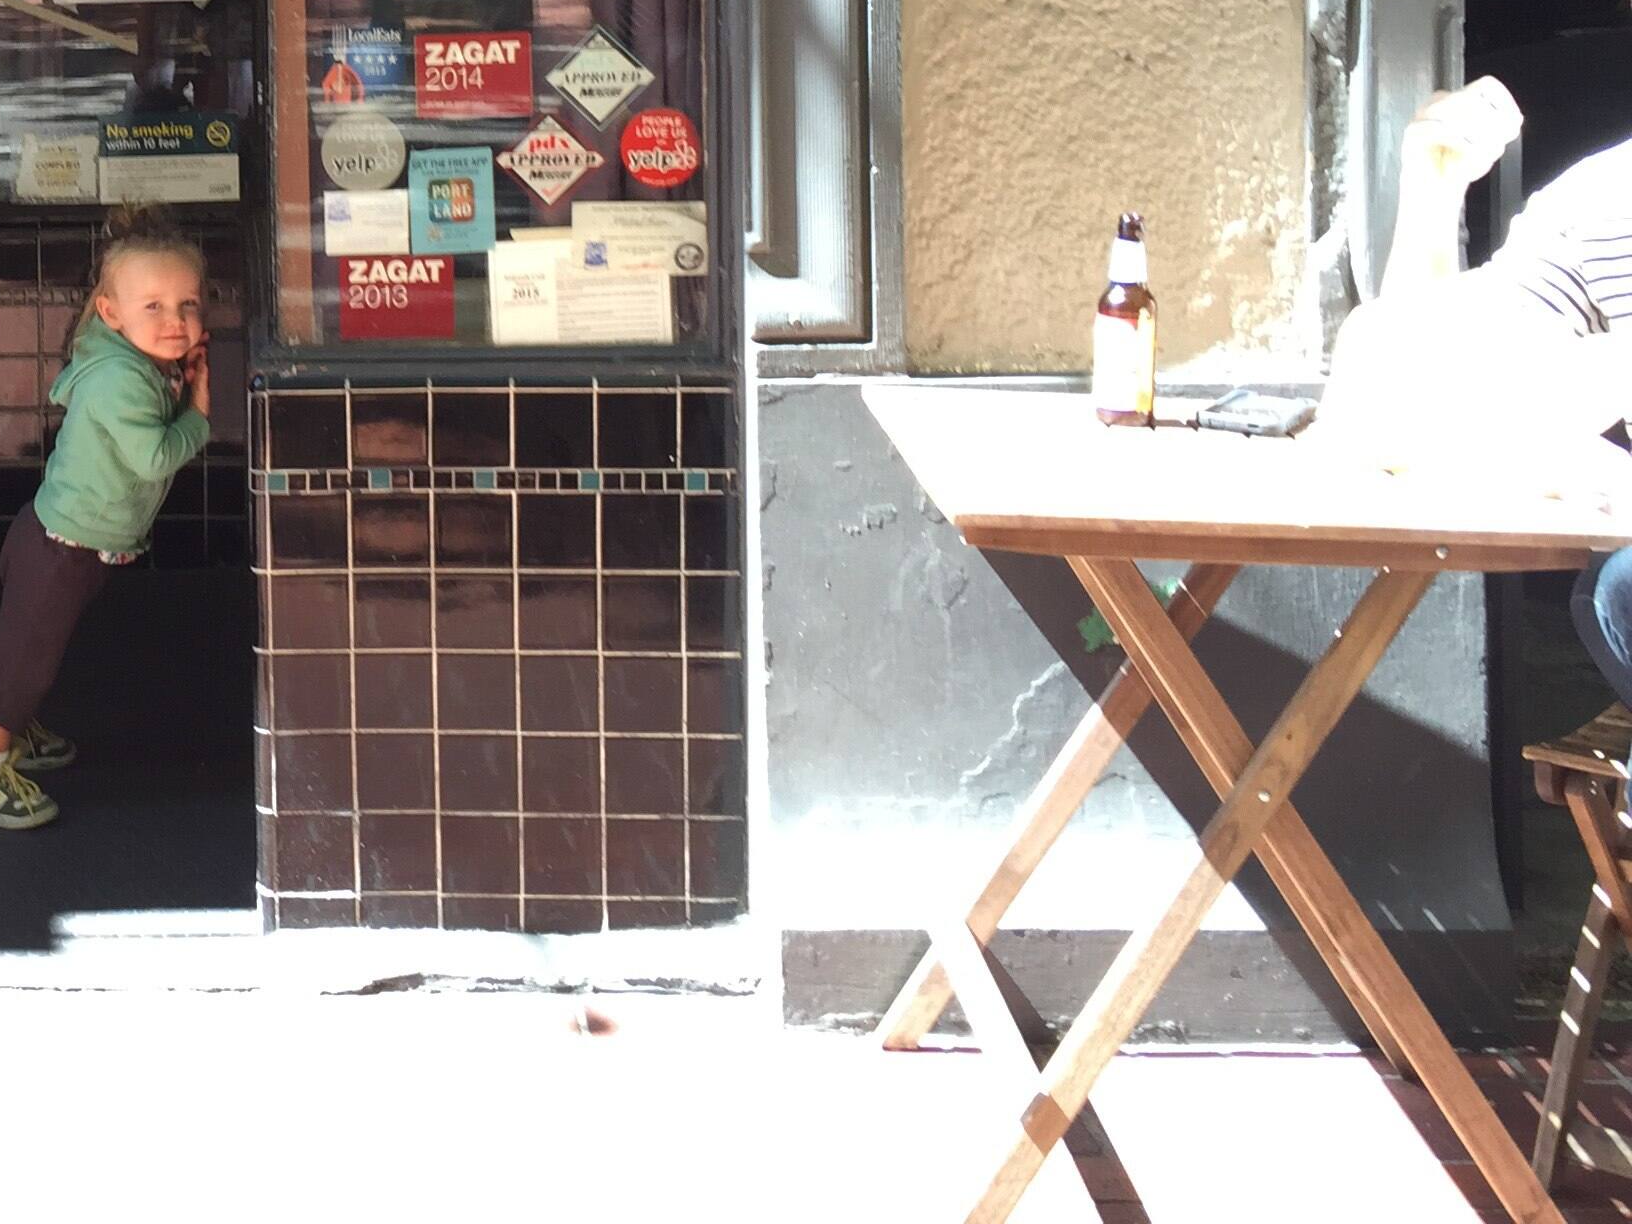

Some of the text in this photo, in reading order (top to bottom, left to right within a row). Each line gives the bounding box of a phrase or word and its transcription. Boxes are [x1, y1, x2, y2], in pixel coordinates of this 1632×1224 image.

[424, 39, 521, 66] ZAGAT
[424, 66, 485, 92] 2014
[106, 121, 193, 140] No smoking
[635, 125, 668, 138] LOVE
[106, 136, 181, 152] within 10 feet
[528, 134, 571, 153] pdx
[333, 152, 377, 176] yelp
[509, 152, 597, 167] APPROVED
[628, 146, 675, 174] yelp
[431, 183, 470, 200] PORT
[433, 201, 473, 218] LAND
[348, 258, 445, 284] ZAGAT
[348, 285, 408, 309] 2013
